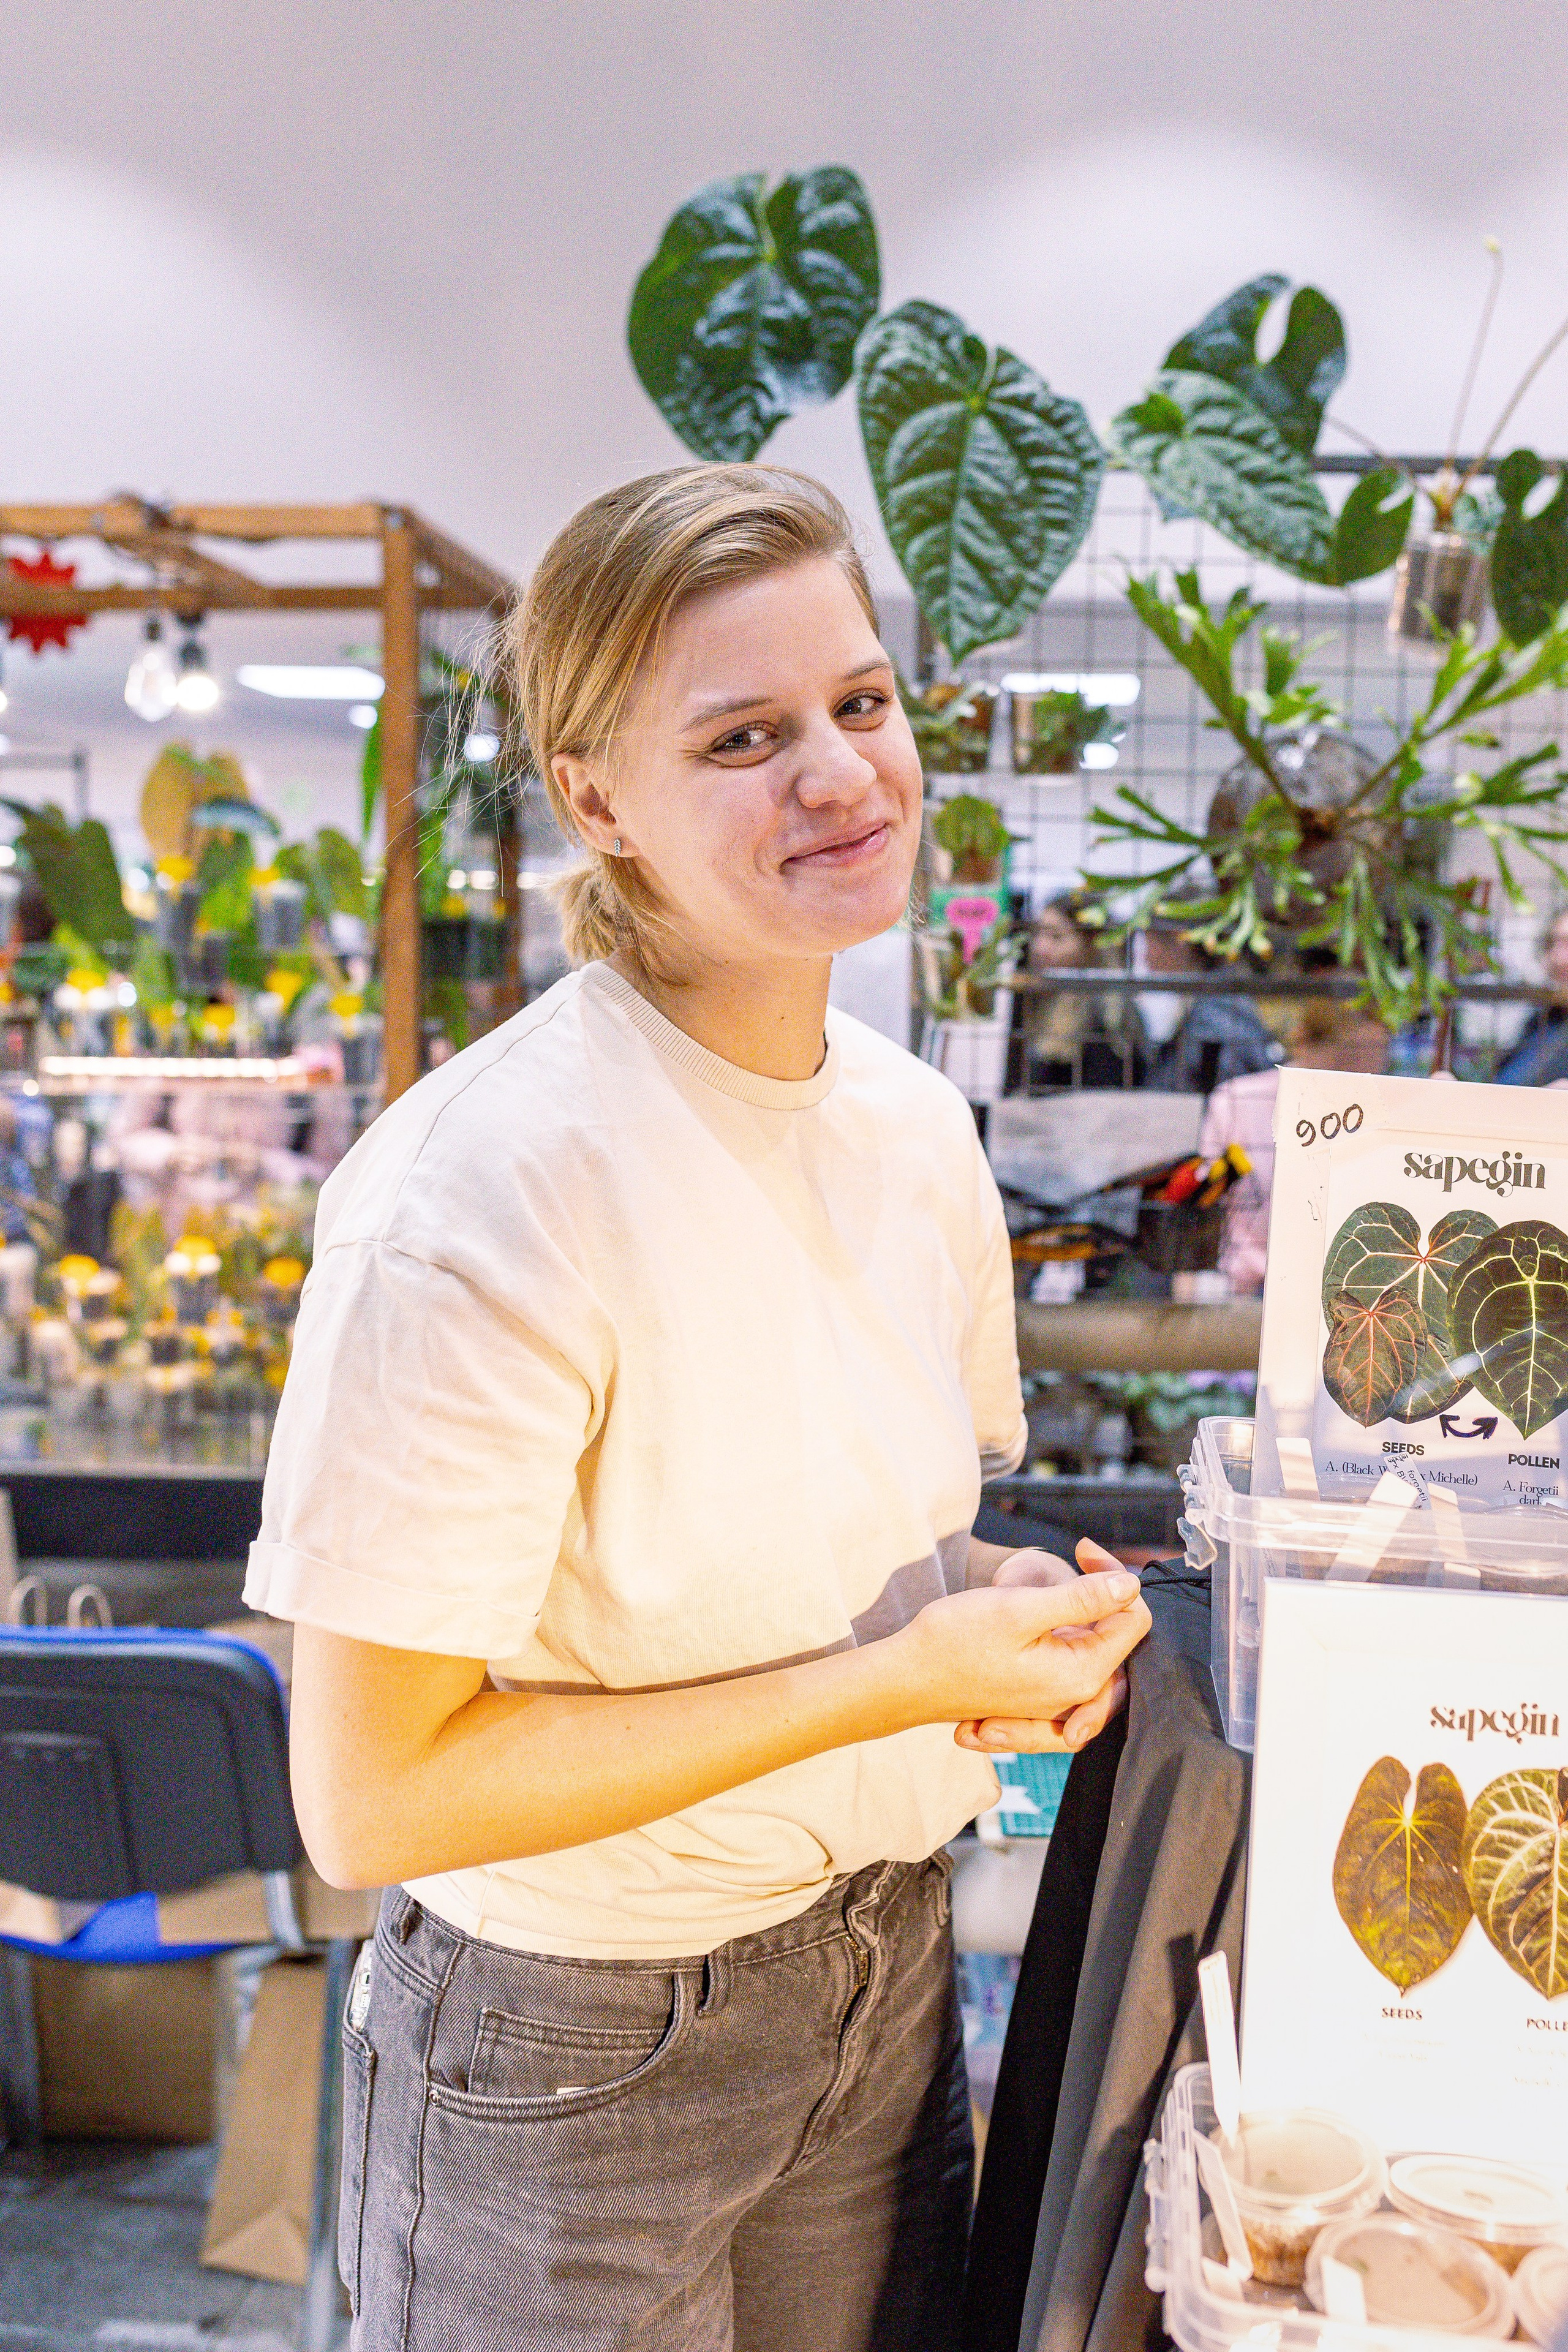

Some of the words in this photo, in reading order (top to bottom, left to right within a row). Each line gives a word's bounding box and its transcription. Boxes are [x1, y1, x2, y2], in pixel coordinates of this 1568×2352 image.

[1295, 1104, 1363, 1147] 900
[1403, 1151, 1546, 1197] sapegin
[1382, 1441, 1425, 1456] SEEDS
[1508, 1453, 1560, 1469] POLLEN
[1325, 1461, 1338, 1472] A.
[1342, 1461, 1374, 1475] (Black
[1429, 1471, 1478, 1486] Michelle)
[1502, 1480, 1515, 1491] A.
[1519, 1481, 1559, 1497] Forgetii
[1430, 1702, 1559, 1744] sapegin
[1382, 2007, 1422, 2021] SEEDS
